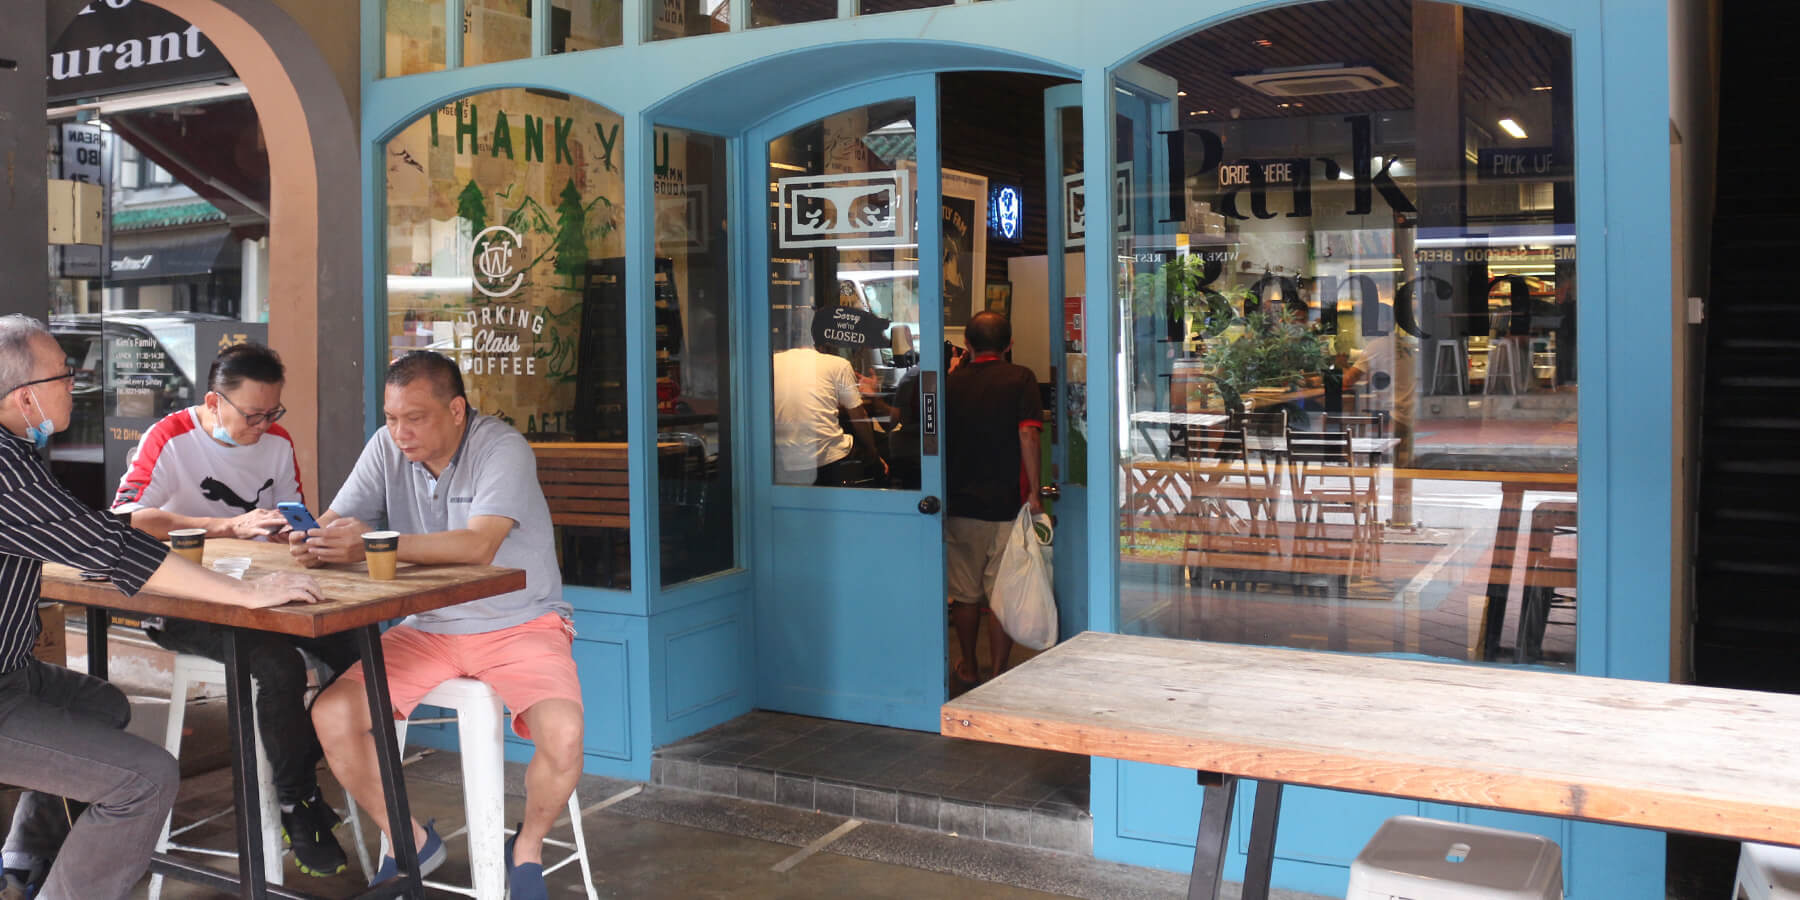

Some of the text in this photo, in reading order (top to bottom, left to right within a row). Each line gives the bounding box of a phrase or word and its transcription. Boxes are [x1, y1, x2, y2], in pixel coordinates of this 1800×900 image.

[1157, 114, 1417, 223] Park
[1493, 154, 1528, 175] PICK
[1219, 164, 1252, 187] ORDE
[833, 308, 861, 325] Sorry
[135, 337, 157, 349] Family
[474, 328, 521, 353] Class
[823, 328, 866, 344] CLOSED
